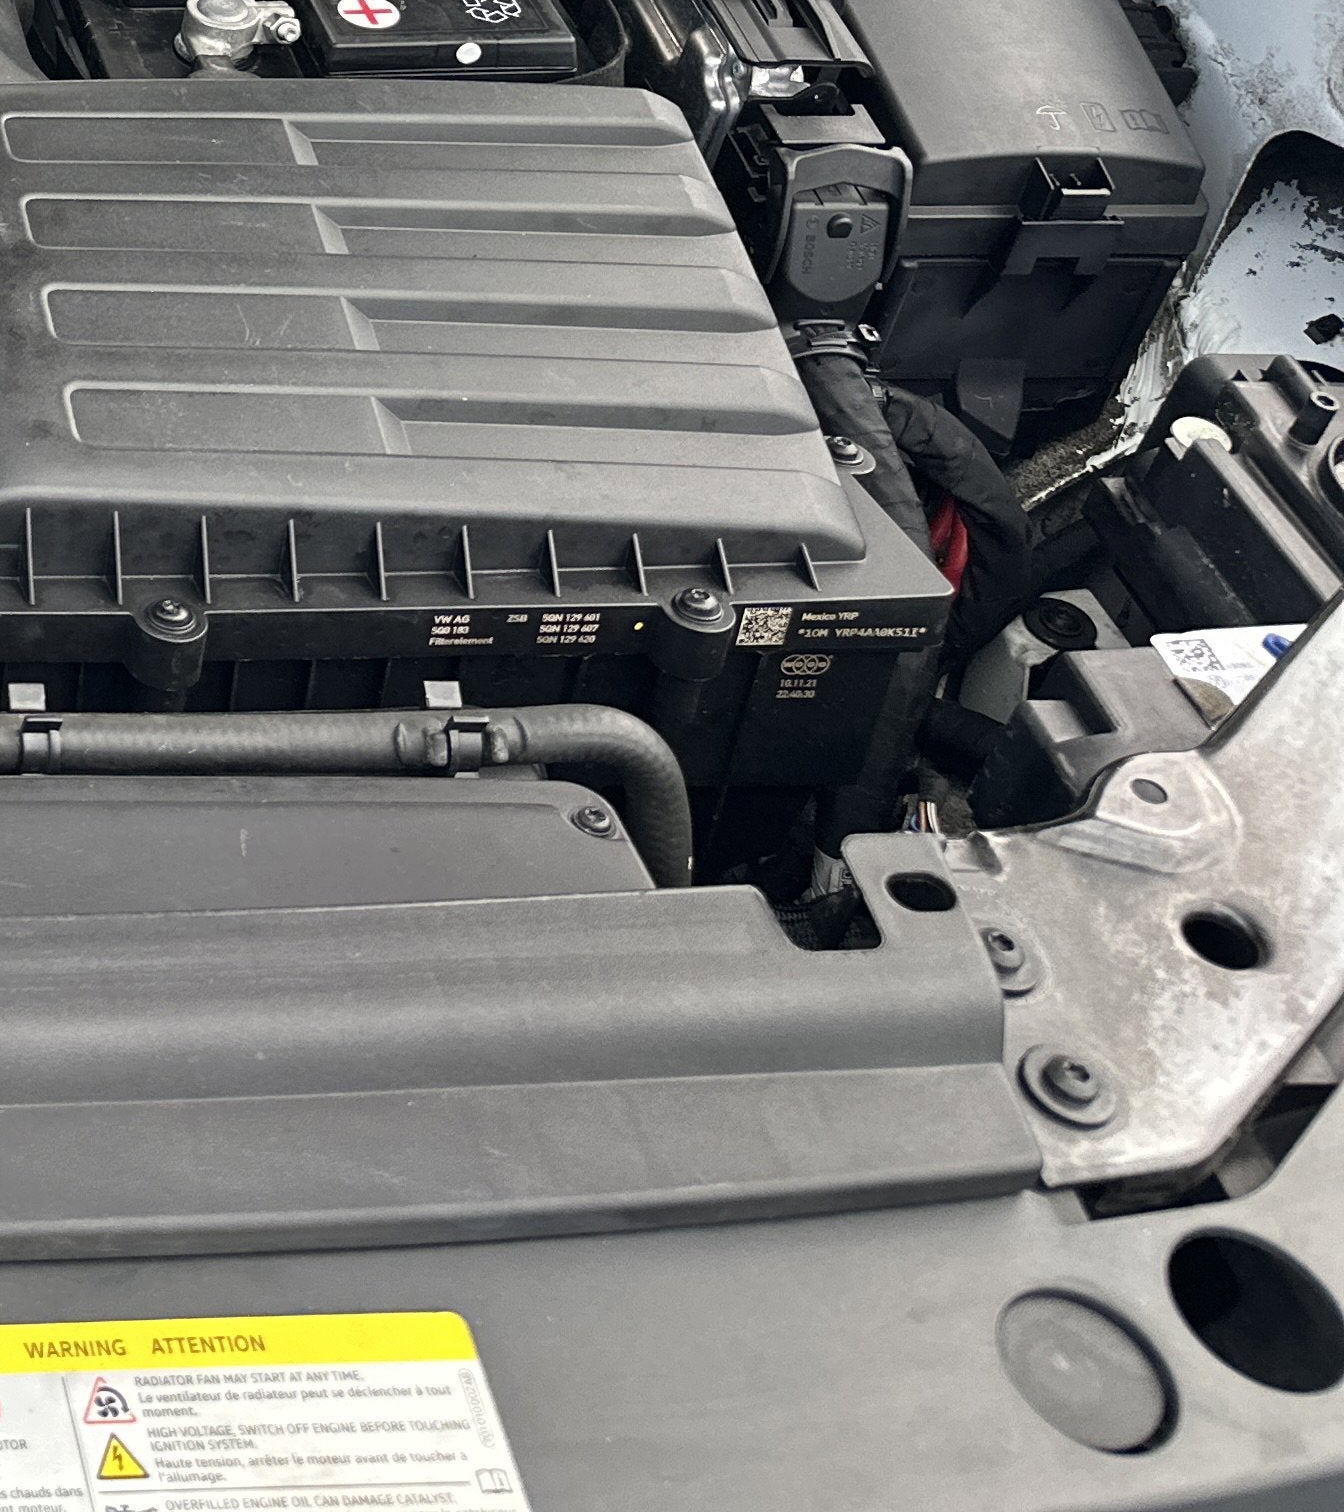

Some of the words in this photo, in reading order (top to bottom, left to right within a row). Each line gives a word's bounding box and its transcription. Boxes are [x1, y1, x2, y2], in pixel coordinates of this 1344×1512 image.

[801, 234, 816, 275] BOSCH
[434, 615, 453, 624] VW
[453, 614, 471, 624] AG
[565, 613, 583, 622] 129
[802, 612, 837, 622] Mexico
[838, 611, 860, 621] YRP
[562, 624, 580, 633] 129
[580, 624, 599, 633] 607
[428, 636, 494, 646] Filterelement
[559, 635, 577, 644] 129
[23, 1339, 127, 1359] WARNING
[151, 1335, 266, 1355] ATTENTION
[134, 1374, 193, 1387] RADIATOR
[197, 1374, 221, 1386] FAN
[223, 1373, 248, 1385] MAY
[251, 1372, 286, 1384] START
[332, 1370, 365, 1382] TIME.
[155, 1391, 222, 1403] ventilateur
[242, 1389, 298, 1401] radiateur
[348, 1386, 413, 1399] déclencher
[142, 1407, 198, 1418] moment.
[147, 1426, 178, 1438] HIGH
[180, 1424, 236, 1438] VOLTAGE,
[238, 1423, 284, 1435] SWITCH
[311, 1422, 357, 1434] ENGINE
[360, 1421, 406, 1433] BEFORE
[409, 1419, 471, 1432] TOUCHING
[150, 1440, 205, 1452] IGNITION
[207, 1438, 258, 1450] SYSTEM.
[155, 1457, 192, 1469] Haute
[307, 1453, 352, 1465] moteur
[409, 1451, 457, 1463] toucher
[9, 1486, 53, 1499] chauds
[55, 1486, 84, 1497] dans
[165, 1498, 240, 1511] OVERFILLED
[243, 1497, 288, 1509] ENGINE
[343, 1494, 394, 1506] DAMAGE
